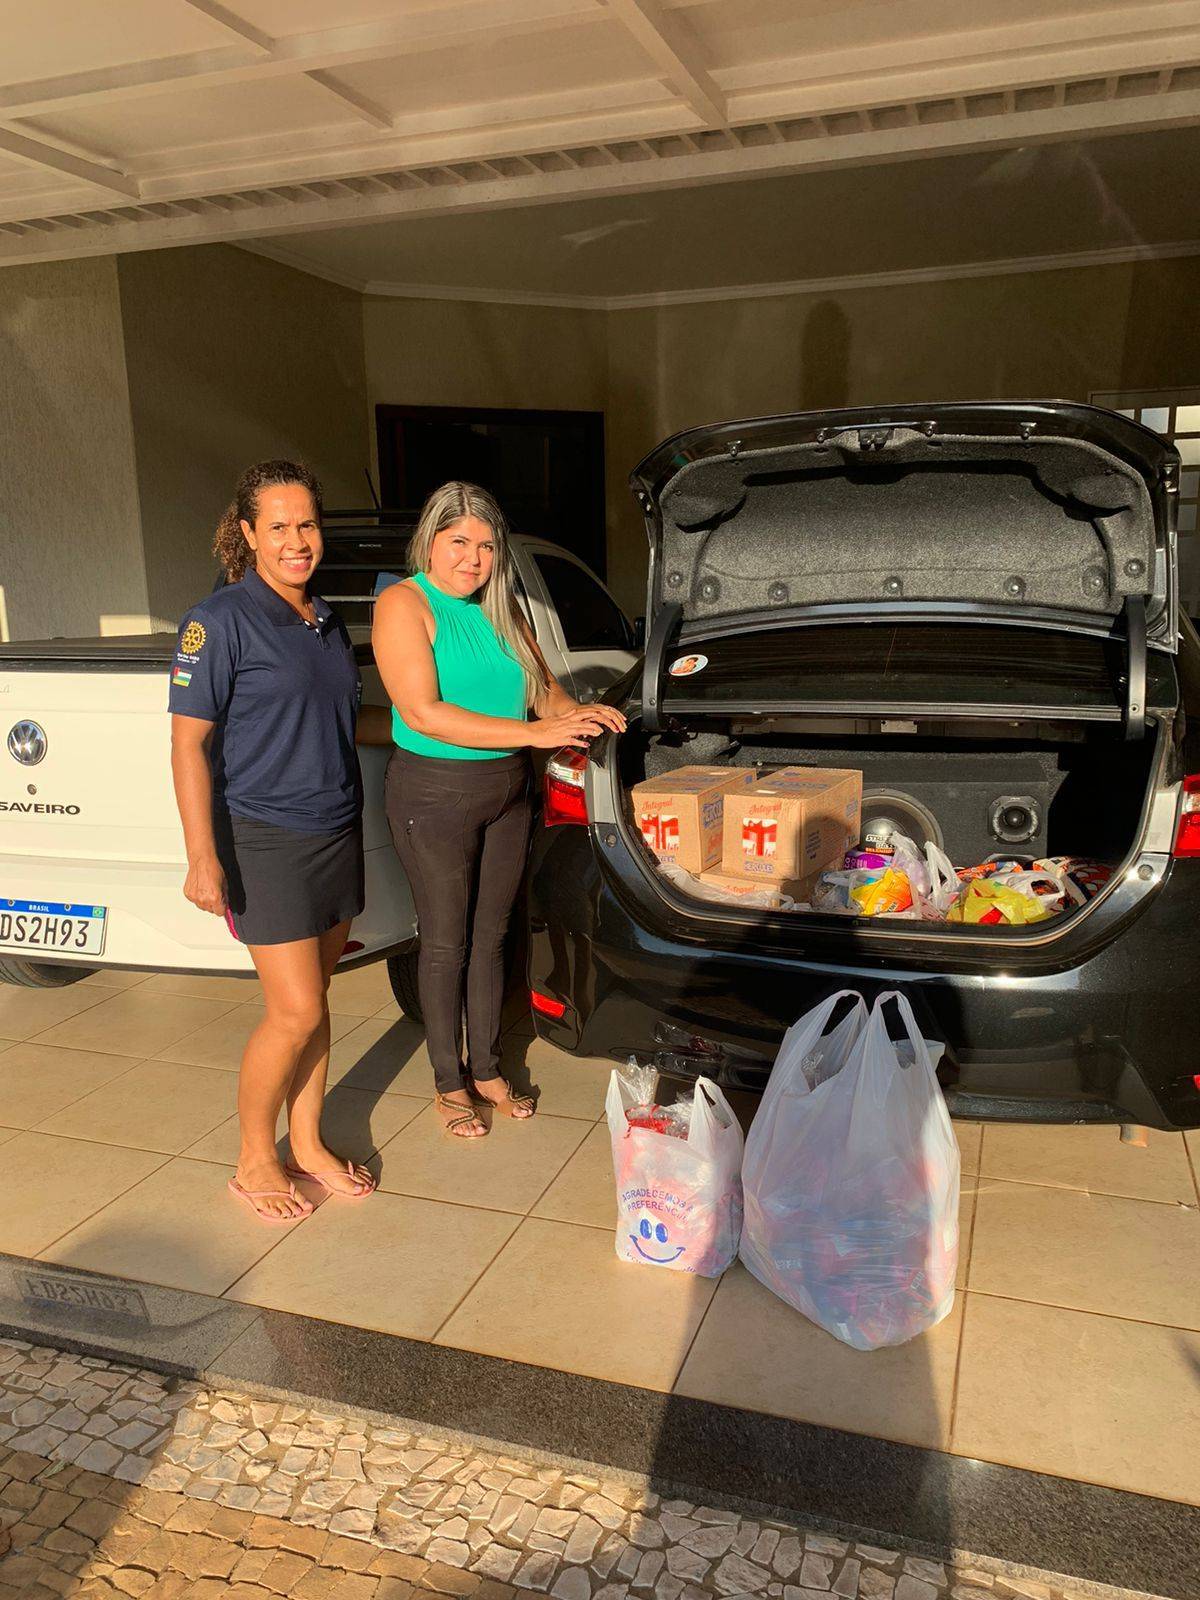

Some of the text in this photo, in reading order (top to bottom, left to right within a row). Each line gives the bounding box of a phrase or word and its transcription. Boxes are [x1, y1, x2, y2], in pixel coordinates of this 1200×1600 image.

[0, 802, 80, 815] SAVEIRO
[28, 904, 50, 912] BRASIL
[0, 914, 90, 948] DS2H93
